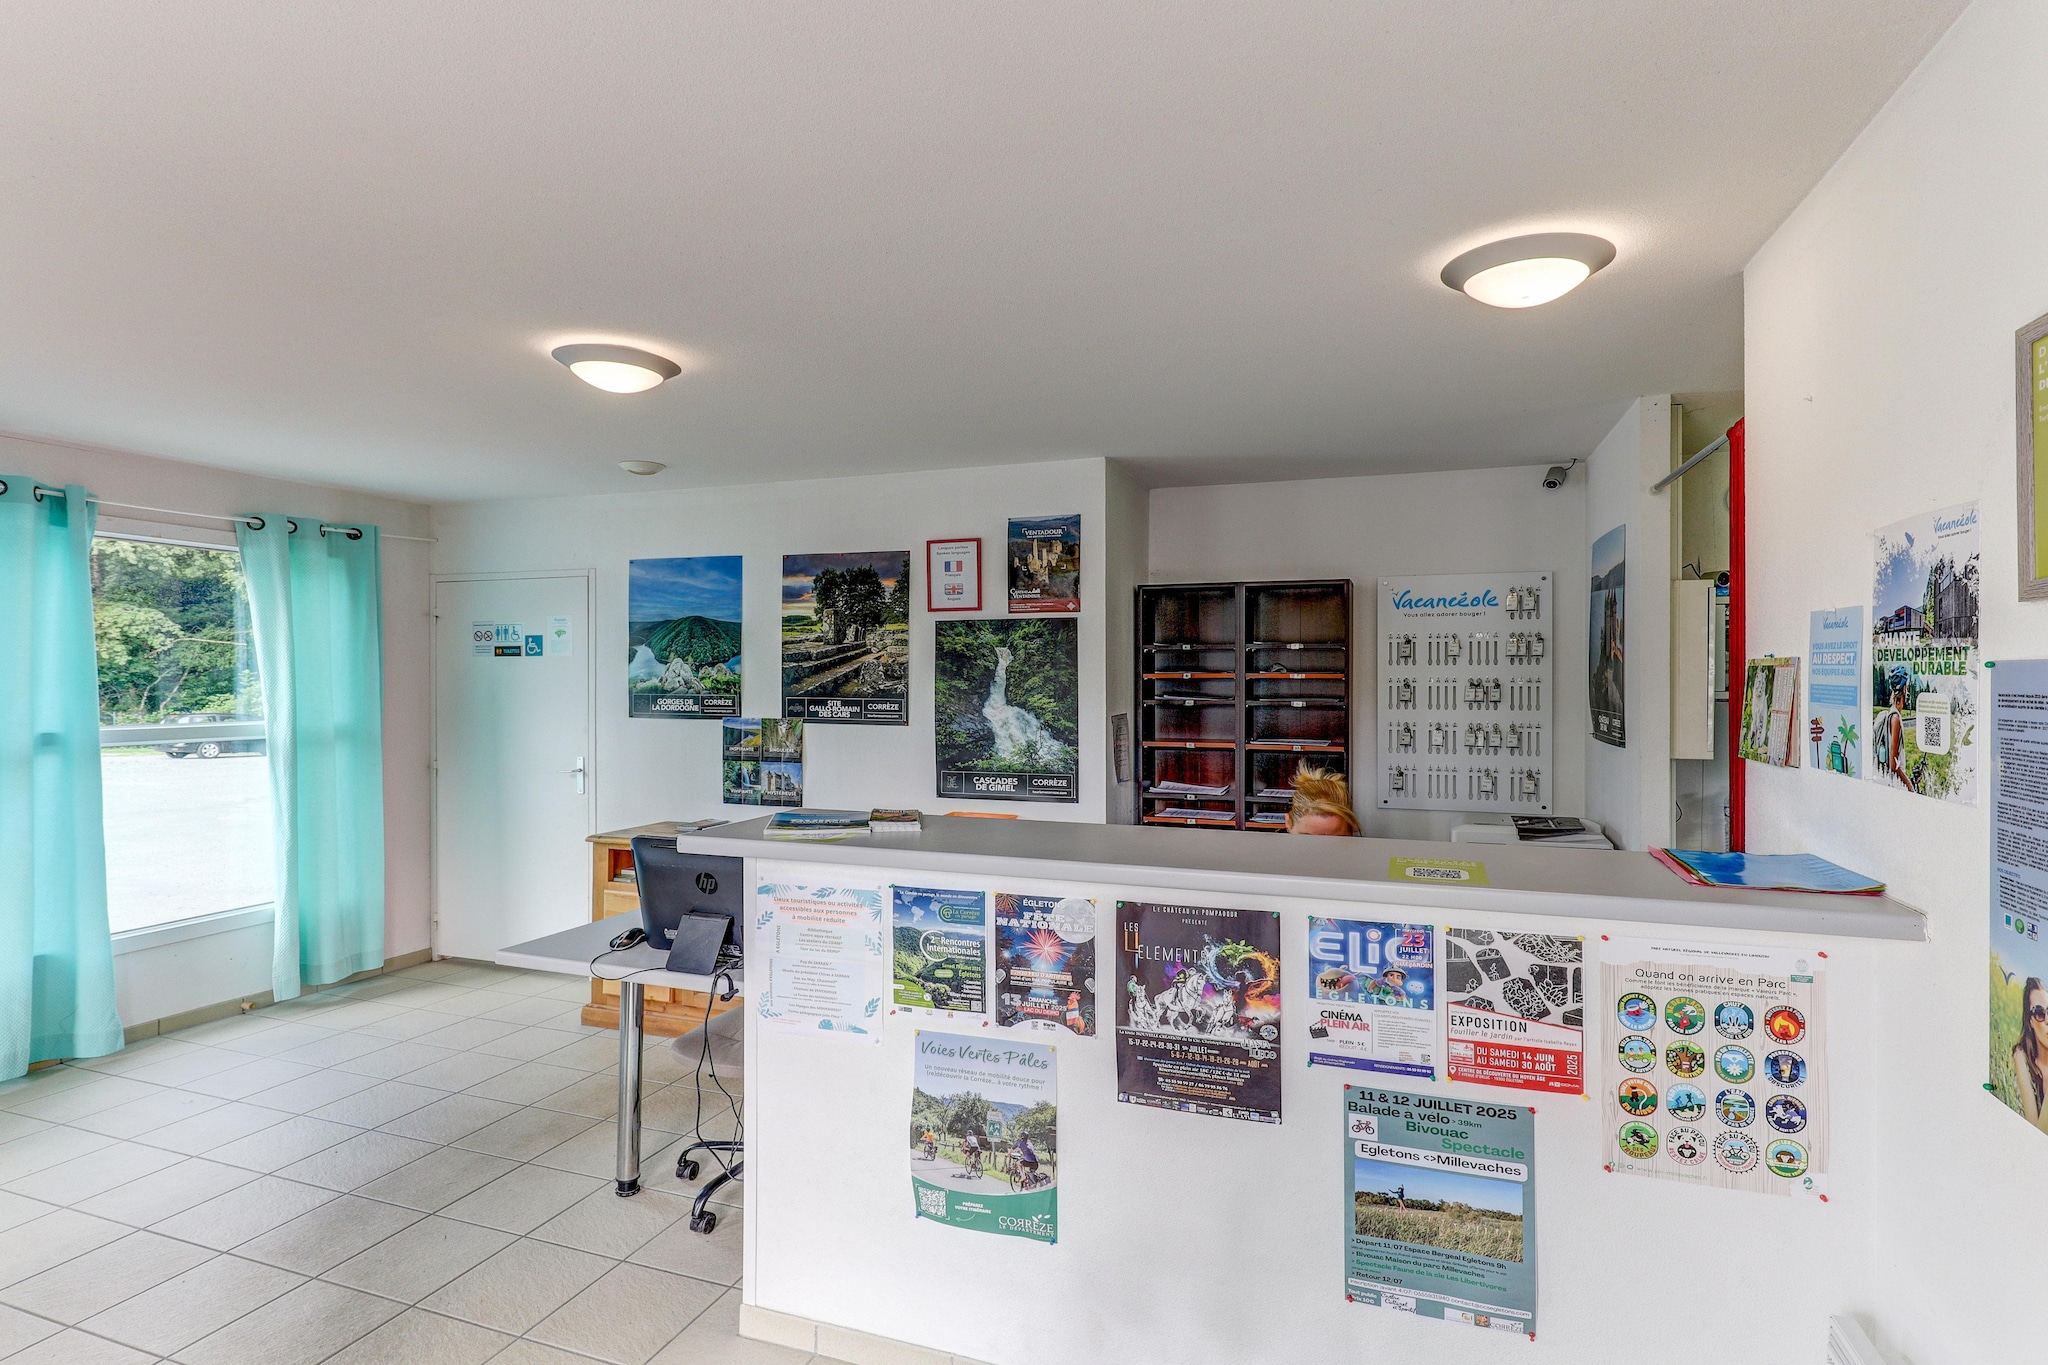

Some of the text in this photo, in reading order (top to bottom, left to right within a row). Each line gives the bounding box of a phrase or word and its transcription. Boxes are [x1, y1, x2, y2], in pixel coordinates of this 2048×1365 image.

[1933, 510, 1977, 533] Vacancéole
[1393, 589, 1499, 610] Vacancéole
[1843, 641, 1858, 649] DROIT
[1880, 631, 1920, 646] CHARTE
[1812, 653, 1857, 666] AU RESPECT,
[1877, 646, 1970, 661] DÉVELOPPEMENT
[1913, 661, 1967, 675] DURABLE
[868, 702, 899, 710] CORRÈZE
[973, 777, 1018, 785] CASCADES
[989, 784, 1016, 792] GIMEL
[1032, 778, 1067, 787] CORRÈZE
[698, 872, 716, 895] hp
[790, 898, 826, 906] touristiques
[837, 900, 863, 908] activités
[1023, 898, 1066, 909] ÉGLETONS
[1023, 910, 1065, 923] FÊTE
[1163, 905, 1190, 915] CHÂTEAU
[1202, 909, 1238, 918] POMPADOUR
[996, 917, 1094, 933] NATIONALE
[1124, 922, 1139, 932] LES
[941, 936, 980, 948] Rencontres
[1401, 932, 1425, 947] 23
[927, 943, 981, 955] Internationales
[1635, 968, 1786, 989] Quand on arrive en Parc
[1676, 981, 1711, 989] bénéficiaires
[1001, 992, 1021, 1006] 13
[1022, 1001, 1050, 1009] JUILLET
[1029, 997, 1058, 1005] DIMANCHE
[1316, 990, 1429, 1010] EGLETONS
[1321, 1009, 1363, 1022] CINÉMA
[1320, 1018, 1370, 1031] PLEIN AIR
[1451, 1015, 1528, 1033] EXPOSITION
[1450, 1028, 1479, 1037] Fouiller
[1489, 1031, 1513, 1040] jardin
[921, 1041, 1049, 1070] Voies Vertes Pâles
[1477, 1047, 1554, 1063] DU SAMEDI 14 JUIN
[1476, 1057, 1556, 1072] AU SAMEDI 30 AOÛT
[1567, 1055, 1578, 1075] 2025
[927, 1070, 962, 1080] (re)découvrir
[1018, 1083, 1039, 1091] rythme
[959, 1067, 978, 1076] réseau
[988, 1071, 1011, 1080] mobilité
[1483, 1069, 1511, 1078] DÉCOUVERTE
[1359, 1090, 1517, 1120] 11 & 12 JUILLET 2025
[1348, 1101, 1482, 1128] Balade à vélo 39km
[1406, 1121, 1469, 1140] Bivouac
[1669, 1129, 1705, 1147] FACE PATOU
[1717, 1135, 1755, 1154] FACE PATOU
[1361, 1144, 1420, 1161] Egletons
[1441, 1138, 1525, 1159] Spectacle
[1356, 1238, 1495, 1267] Départ Espace Bergeal Egletons
[1356, 1251, 1384, 1261] Bivouac
[1385, 1256, 1411, 1265] Maison
[1442, 1265, 1485, 1278] Millevaches
[1356, 1259, 1392, 1270] Spectacle
[1393, 1266, 1415, 1274] Faune
[1460, 1277, 1507, 1292] Libertivores
[1356, 1271, 1381, 1280] Retour
[1350, 1279, 1379, 1289] Inscription
